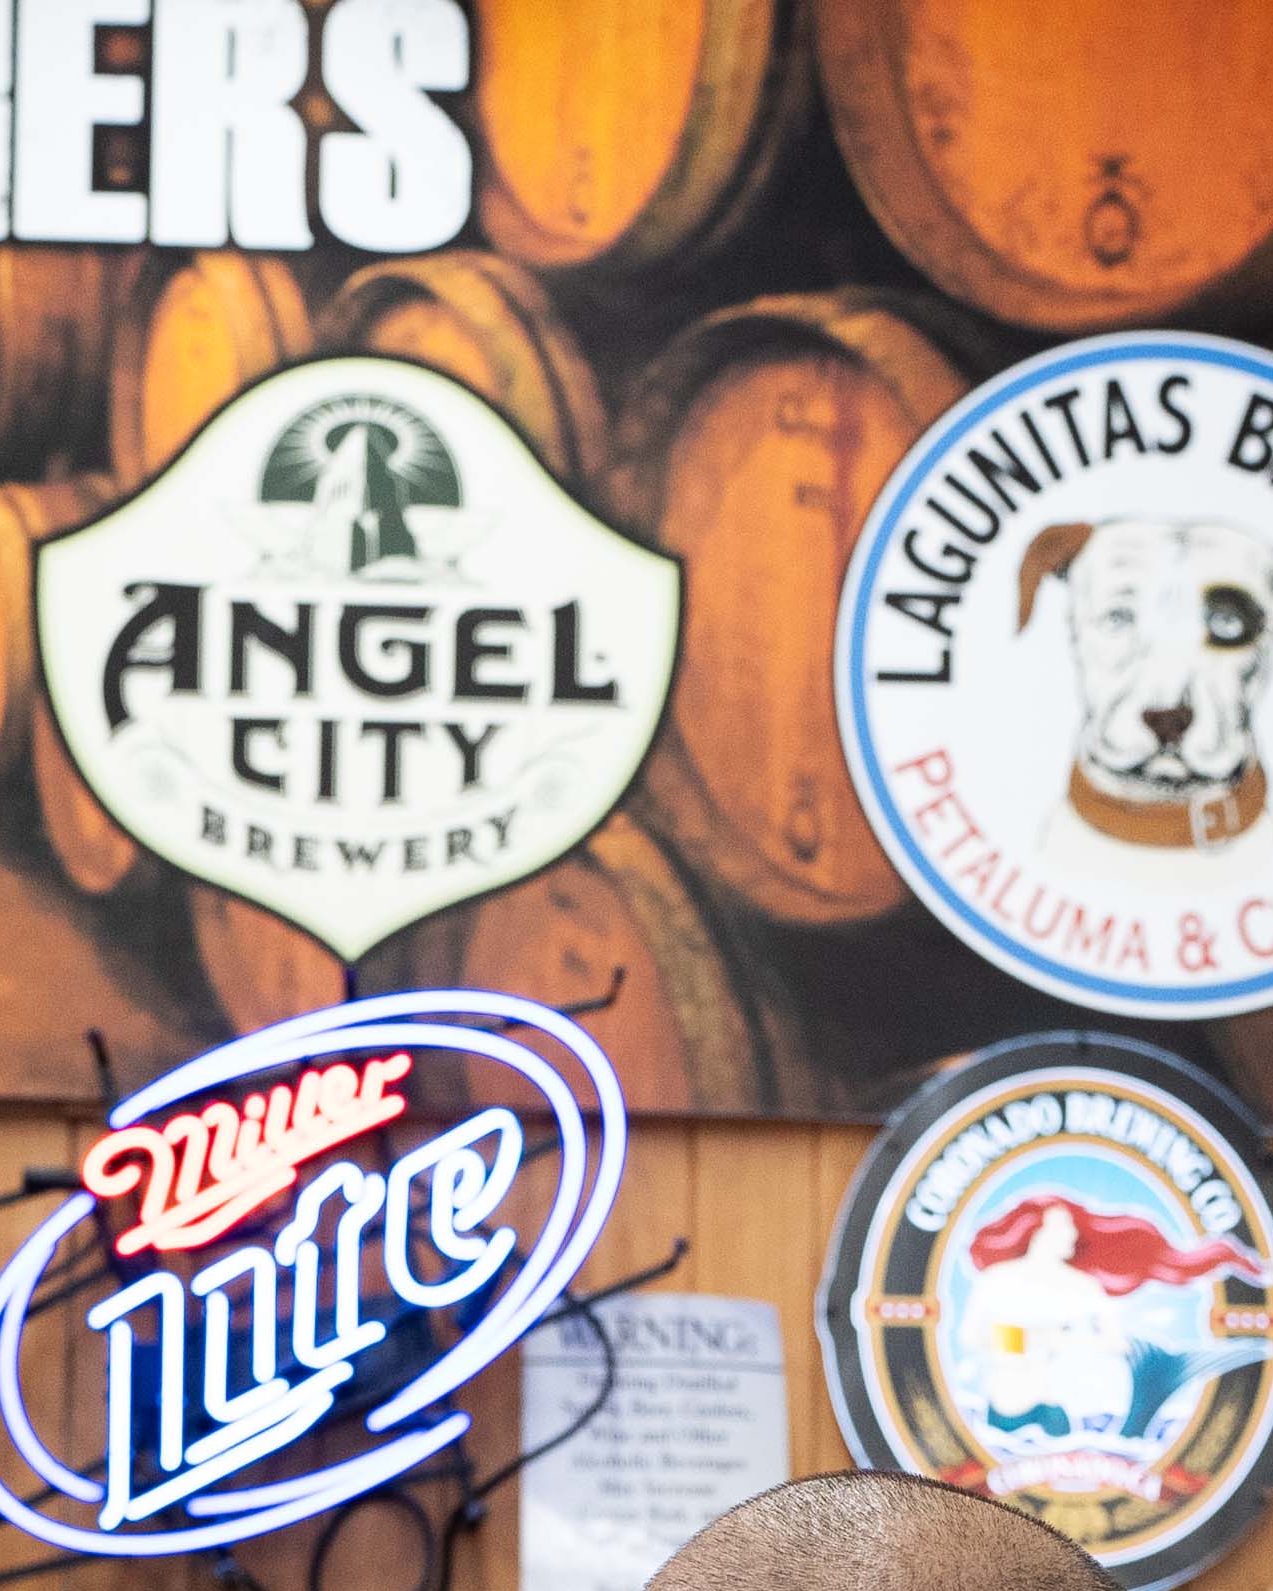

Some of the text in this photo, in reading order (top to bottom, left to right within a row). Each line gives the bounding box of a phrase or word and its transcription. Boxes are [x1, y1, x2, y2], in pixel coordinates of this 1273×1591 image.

[875, 373, 1195, 684] LAGUNITAS
[102, 581, 623, 738] ANGEL
[198, 803, 517, 876] BREWERY
[229, 715, 507, 802] CITY
[892, 747, 1152, 972] PETALUMA
[1176, 911, 1221, 973] &
[81, 1051, 413, 1257] Miller
